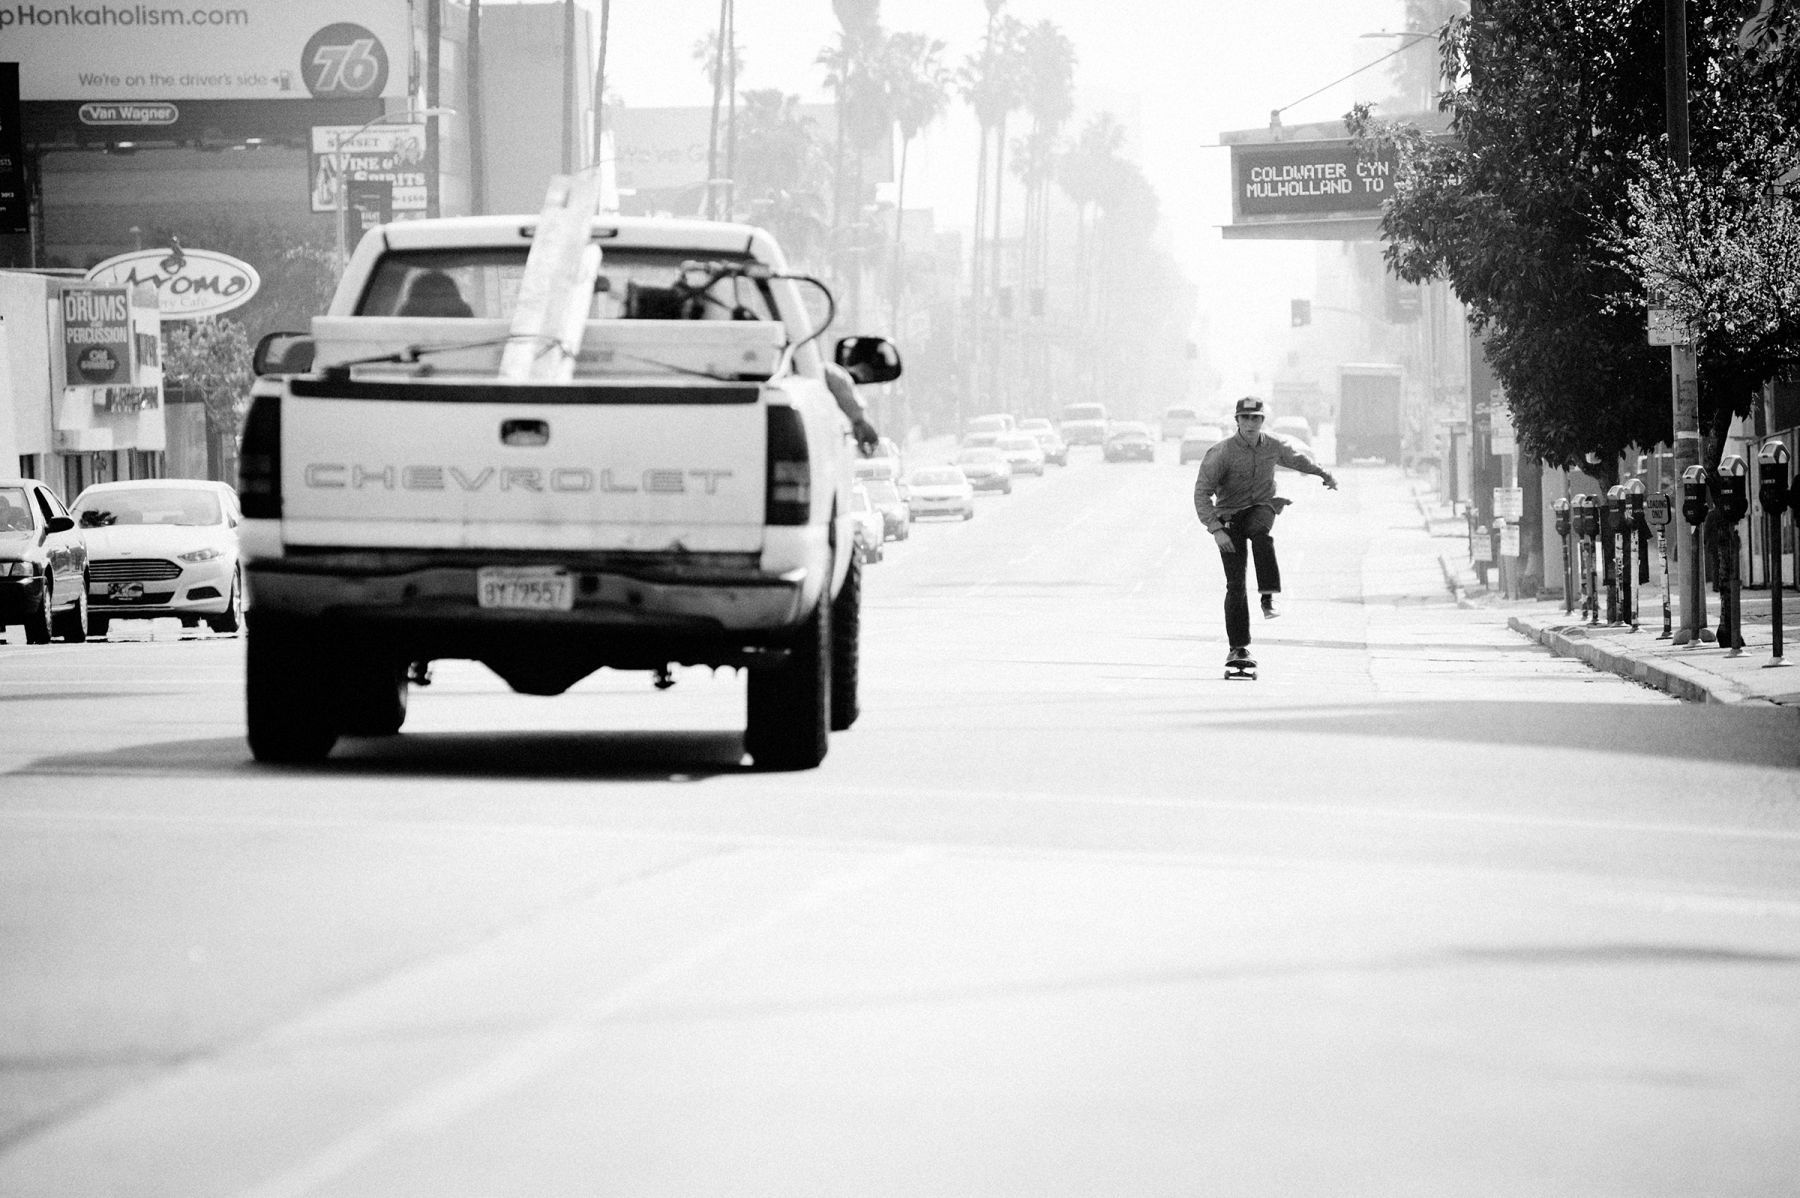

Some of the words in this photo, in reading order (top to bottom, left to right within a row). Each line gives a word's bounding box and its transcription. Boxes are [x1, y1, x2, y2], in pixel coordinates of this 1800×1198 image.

[312, 38, 379, 92] 76
[78, 73, 120, 87] We're
[125, 76, 145, 87] on
[150, 73, 174, 87] the
[180, 73, 231, 87] driver's
[237, 73, 268, 87] side
[89, 107, 115, 120] Van
[119, 107, 172, 122] Wagner
[1251, 163, 1347, 181] COLDWATER
[1356, 162, 1389, 176] CYN
[1246, 179, 1352, 198] MULHOLLAND
[1362, 178, 1384, 192] TO
[65, 294, 127, 322] DRUMS
[67, 326, 128, 344] PERCUSSION
[304, 462, 733, 496] CHEVROLET
[1647, 499, 1668, 509] LOADING
